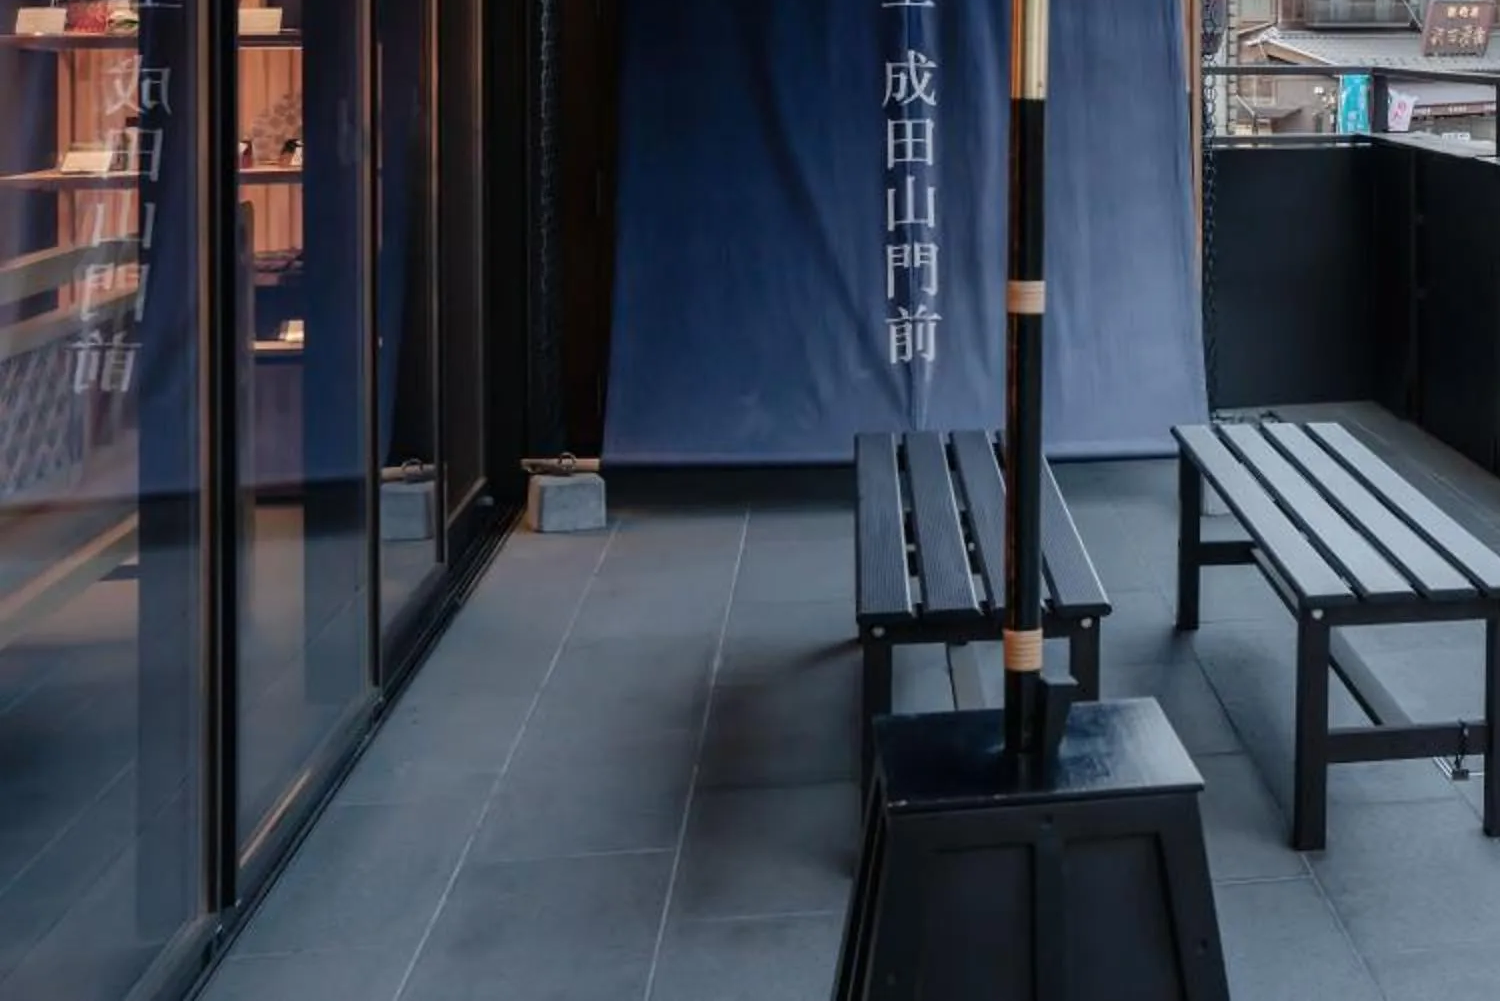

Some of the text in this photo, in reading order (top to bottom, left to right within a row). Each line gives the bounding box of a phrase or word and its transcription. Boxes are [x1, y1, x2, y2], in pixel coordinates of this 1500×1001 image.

[882, 50, 942, 365] 成田山門前
